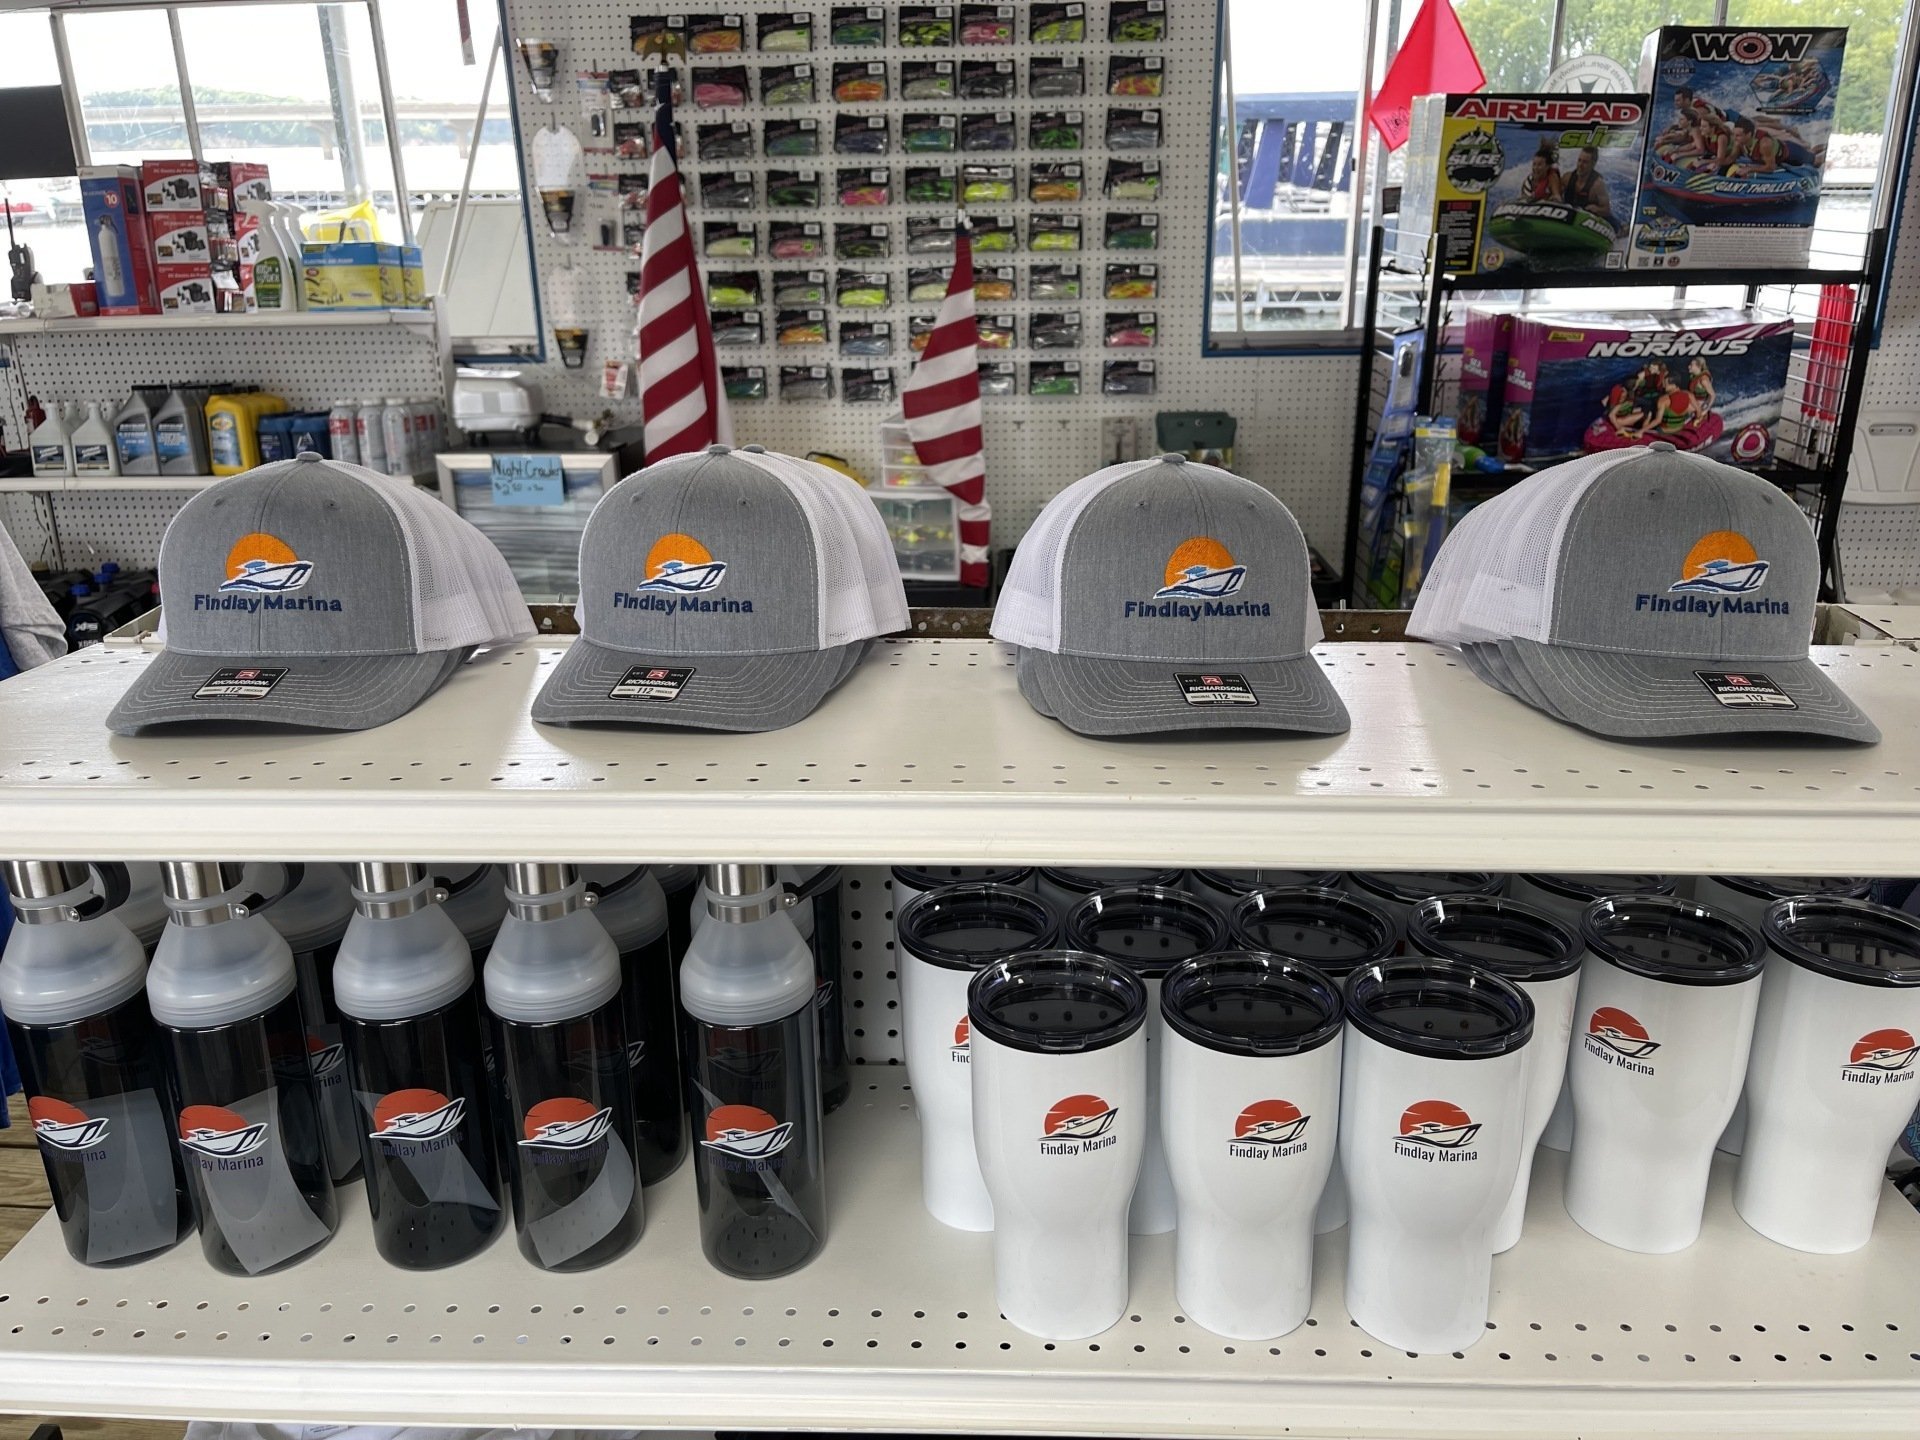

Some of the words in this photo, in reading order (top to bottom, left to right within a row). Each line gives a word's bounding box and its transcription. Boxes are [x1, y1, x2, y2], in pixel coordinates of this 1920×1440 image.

[1692, 32, 1812, 64] WOW
[1453, 98, 1642, 125] AIRHEAD
[1715, 182, 1747, 193] GIANT
[1746, 181, 1796, 193] THRILLER
[106, 195, 118, 204] 10
[1627, 331, 1703, 343] SEA
[1588, 339, 1753, 358] NORMUS
[1512, 367, 1526, 379] SEA
[194, 594, 261, 613] Findlay
[263, 594, 343, 612] Marina
[614, 592, 677, 616] Findlay
[680, 596, 754, 613] Marina
[1125, 601, 1202, 621] Findlay
[1204, 601, 1271, 617] Marina
[1635, 594, 1721, 617] Findlay
[1723, 597, 1790, 615] Marina
[625, 679, 678, 687] RICHARDSON
[1584, 1038, 1614, 1064] Findlay
[1616, 1055, 1655, 1076] Marina
[1842, 1069, 1882, 1085] Findlay
[1884, 1070, 1915, 1083] Marina
[1041, 1143, 1079, 1156] Findlay
[1082, 1135, 1117, 1153] Marina
[1229, 1144, 1270, 1160] Findlay
[1272, 1141, 1308, 1158] Marina
[1394, 1142, 1435, 1163] Findlay
[1438, 1150, 1478, 1162] Marina
[218, 1156, 264, 1171] Marina
